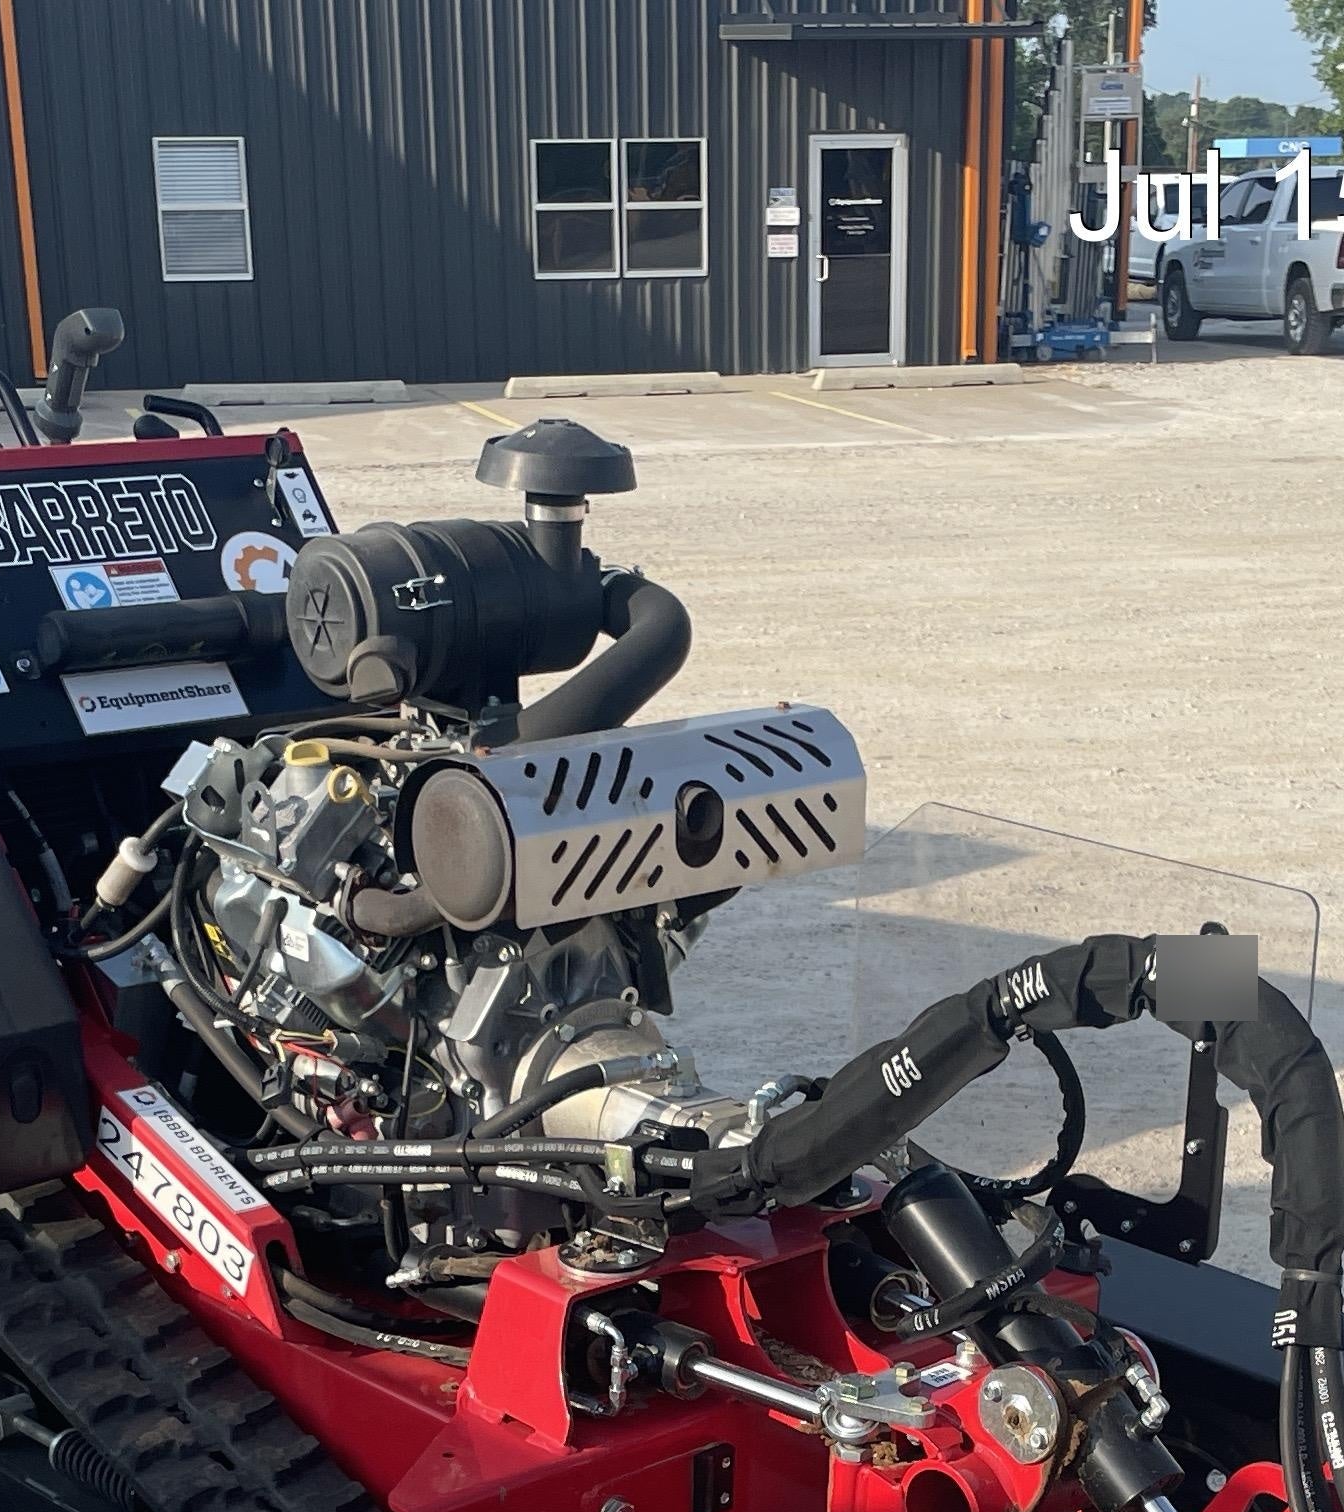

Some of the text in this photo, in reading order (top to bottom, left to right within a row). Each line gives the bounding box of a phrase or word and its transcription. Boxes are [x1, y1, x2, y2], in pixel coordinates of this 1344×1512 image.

[96, 683, 231, 711] EquipmentShare
[1001, 962, 1050, 1013] SHA
[881, 1047, 922, 1097] 055
[153, 1109, 256, 1205] (888) 80-RENTS
[99, 1117, 246, 1282] 247803
[1317, 1377, 1330, 1404] 100R2
